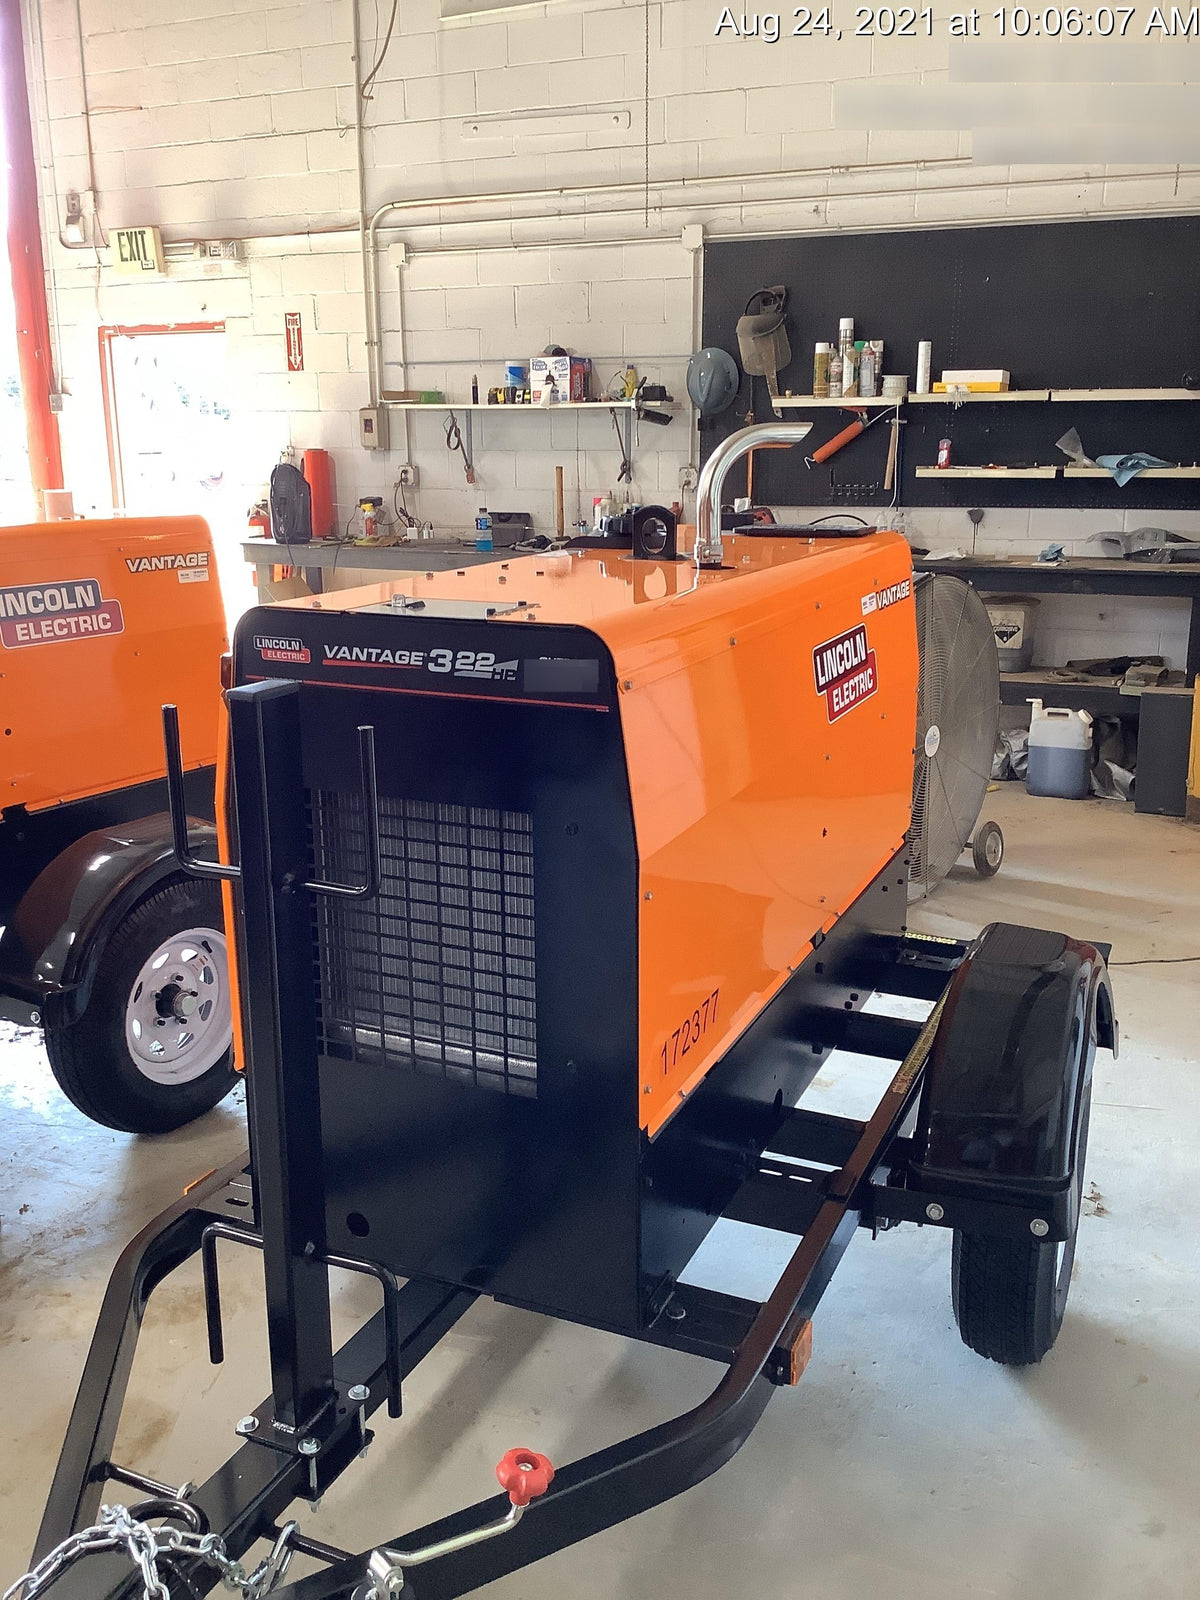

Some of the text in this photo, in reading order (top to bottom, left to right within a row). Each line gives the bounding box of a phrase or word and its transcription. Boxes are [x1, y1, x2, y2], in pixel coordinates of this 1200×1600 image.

[117, 230, 147, 262] EXIT
[288, 318, 299, 327] FIRE
[125, 552, 210, 573] VANTAGE
[0, 584, 96, 618] INCOLN
[877, 579, 911, 610] VANTAGE
[16, 613, 112, 642] ELECTRIC
[256, 638, 300, 651] LINCOLN
[267, 651, 306, 661] ELECTRIC
[323, 644, 424, 666] VANTAGE
[428, 648, 496, 674] 322
[816, 632, 866, 687] LINCOLN
[832, 667, 874, 713] ELECTRIC
[661, 987, 720, 1075] 172377
